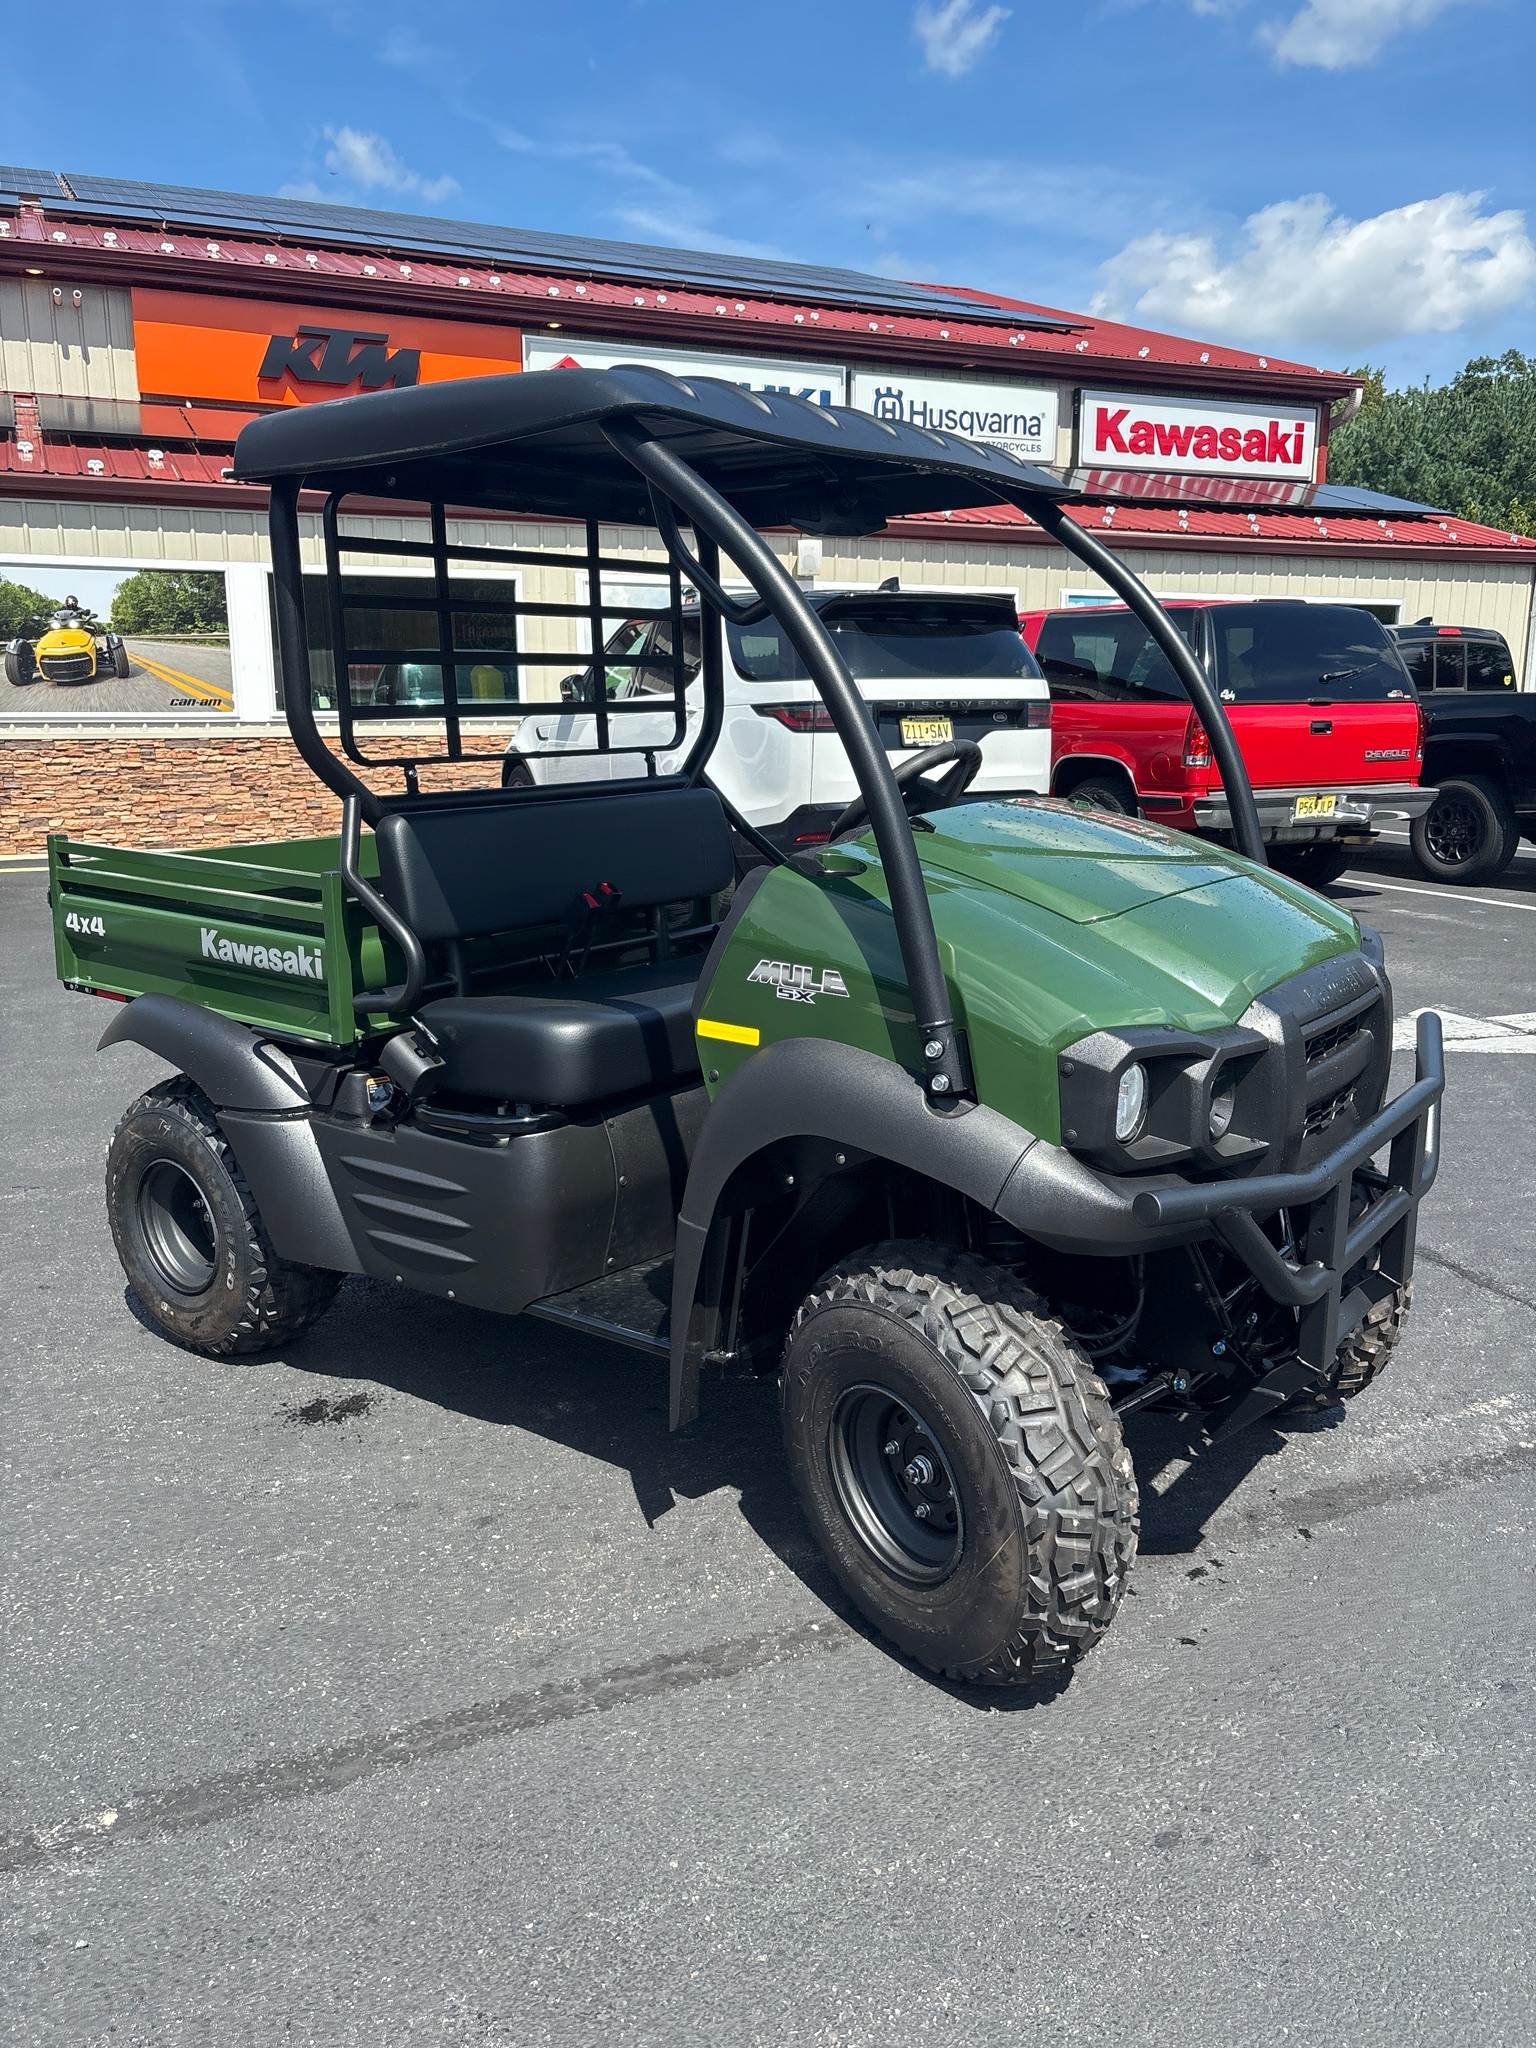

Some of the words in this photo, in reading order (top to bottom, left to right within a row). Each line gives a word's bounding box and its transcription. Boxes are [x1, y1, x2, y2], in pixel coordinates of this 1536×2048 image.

[257, 325, 421, 389] KTM
[909, 400, 1042, 437] Husqvarna
[981, 441, 1042, 453] TORCYCLES
[1095, 406, 1305, 464] Kawasaki
[169, 698, 222, 707] can-am
[897, 700, 1010, 708] DISCOVERY
[1364, 748, 1412, 759] CHEVROLET
[65, 912, 106, 937] 4x4
[200, 927, 323, 980] Kawasaki
[746, 959, 850, 997] MULE
[776, 986, 816, 1004] SX
